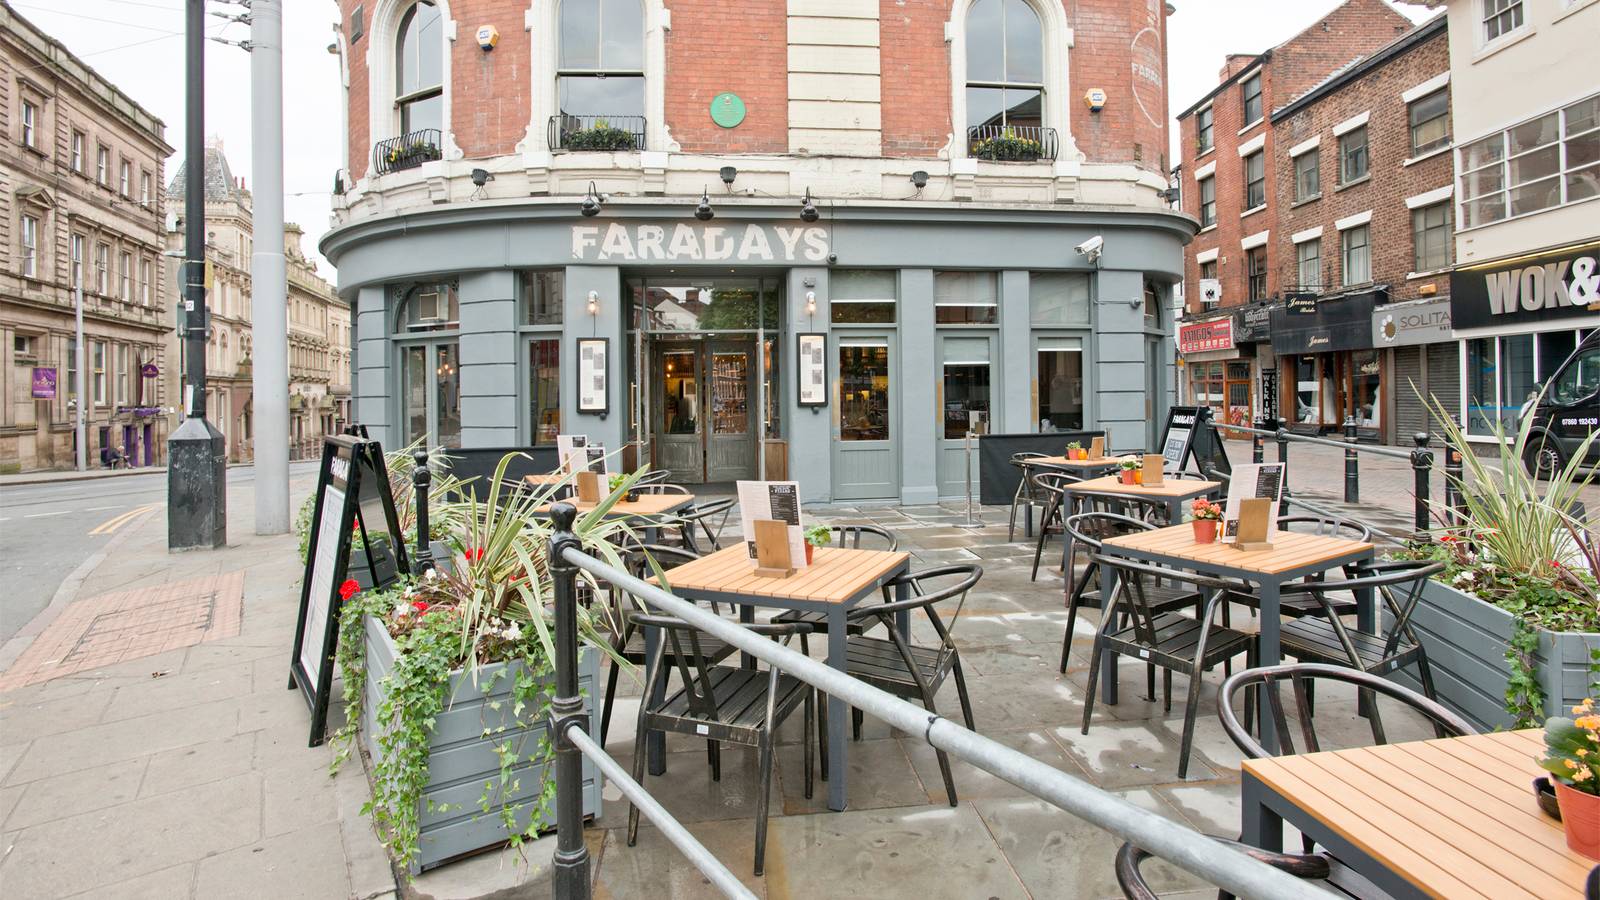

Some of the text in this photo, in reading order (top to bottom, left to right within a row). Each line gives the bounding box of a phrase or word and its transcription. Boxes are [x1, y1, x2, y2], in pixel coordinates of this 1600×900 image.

[571, 222, 831, 262] FARADAYS
[1287, 297, 1315, 309] James
[1308, 336, 1329, 347] James
